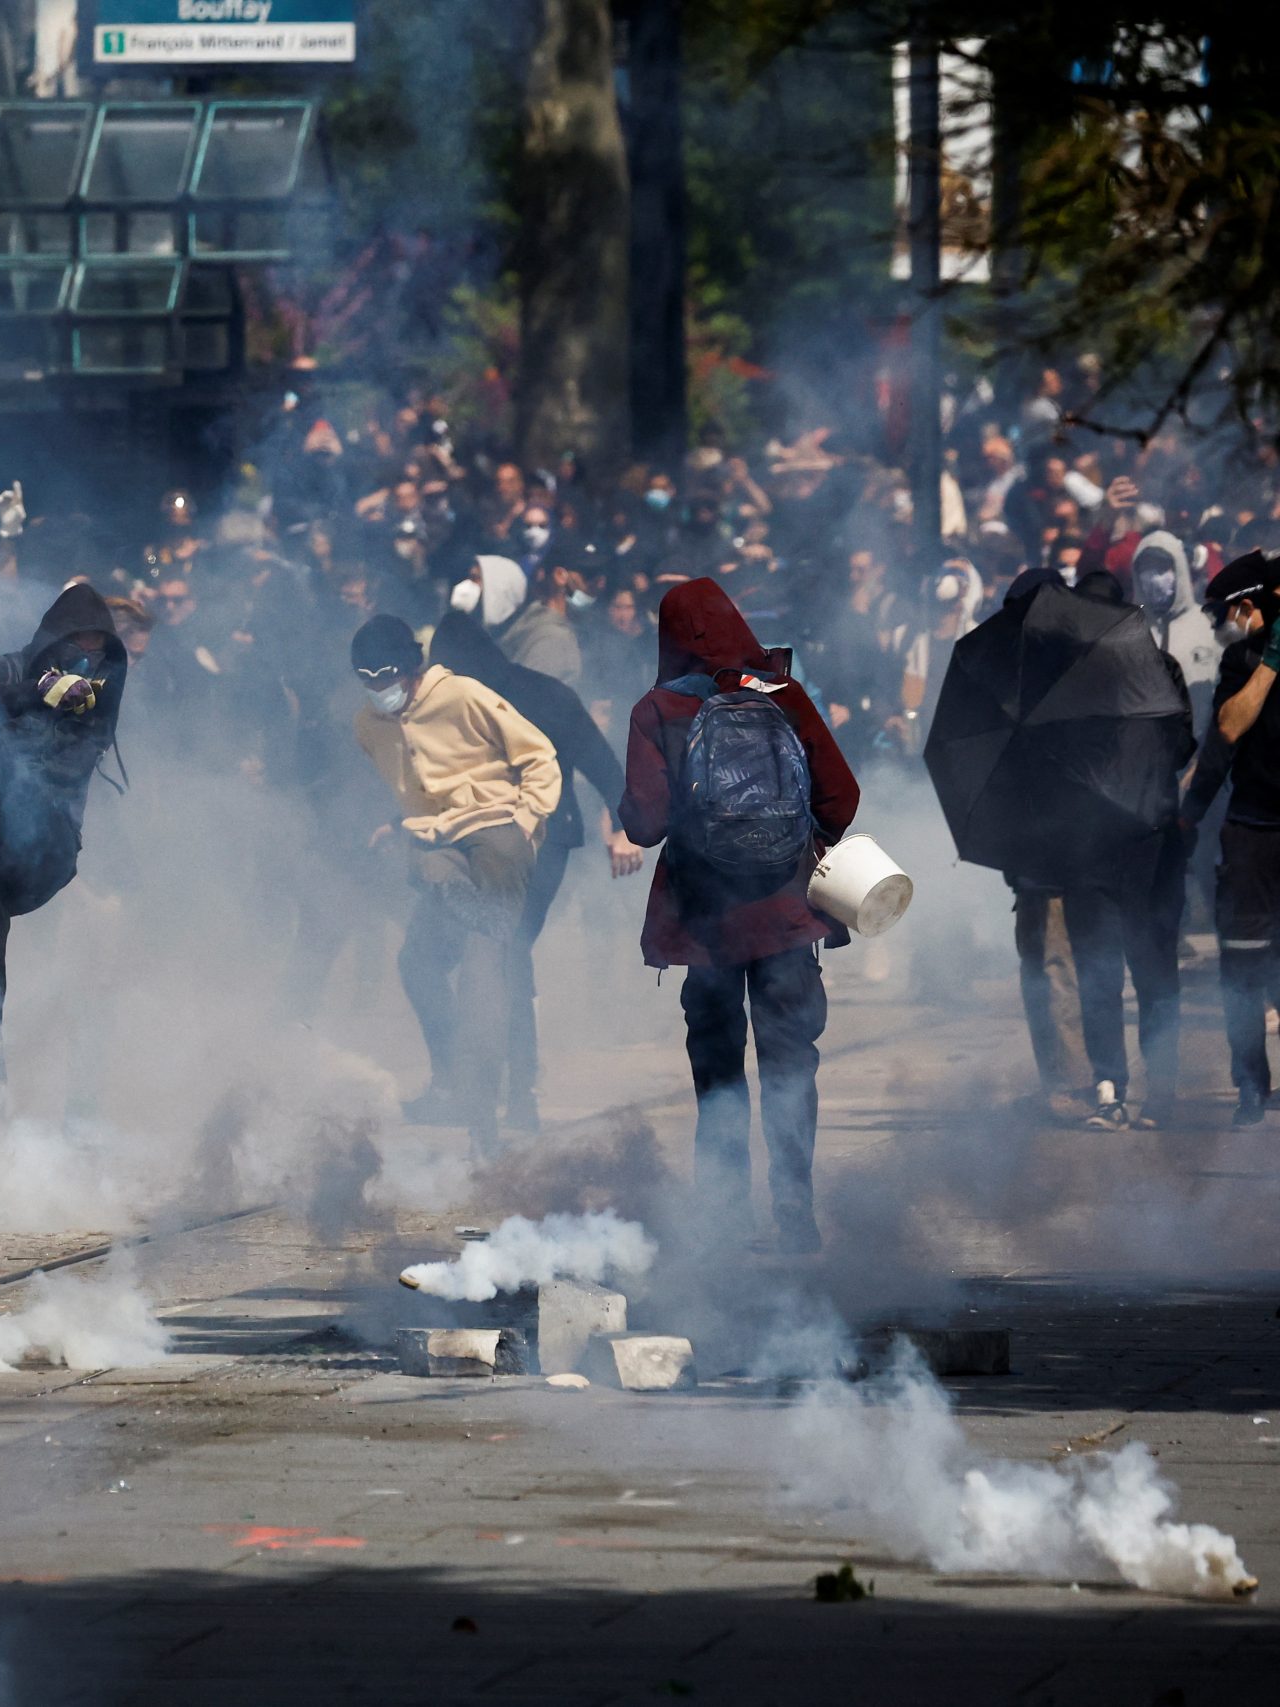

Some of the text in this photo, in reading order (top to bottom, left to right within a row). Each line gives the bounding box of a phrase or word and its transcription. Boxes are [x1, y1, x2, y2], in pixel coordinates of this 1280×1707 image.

[178, 0, 272, 24] Bouffay
[109, 32, 119, 54] 1
[130, 34, 194, 53] François
[199, 33, 284, 50] Mitterrand
